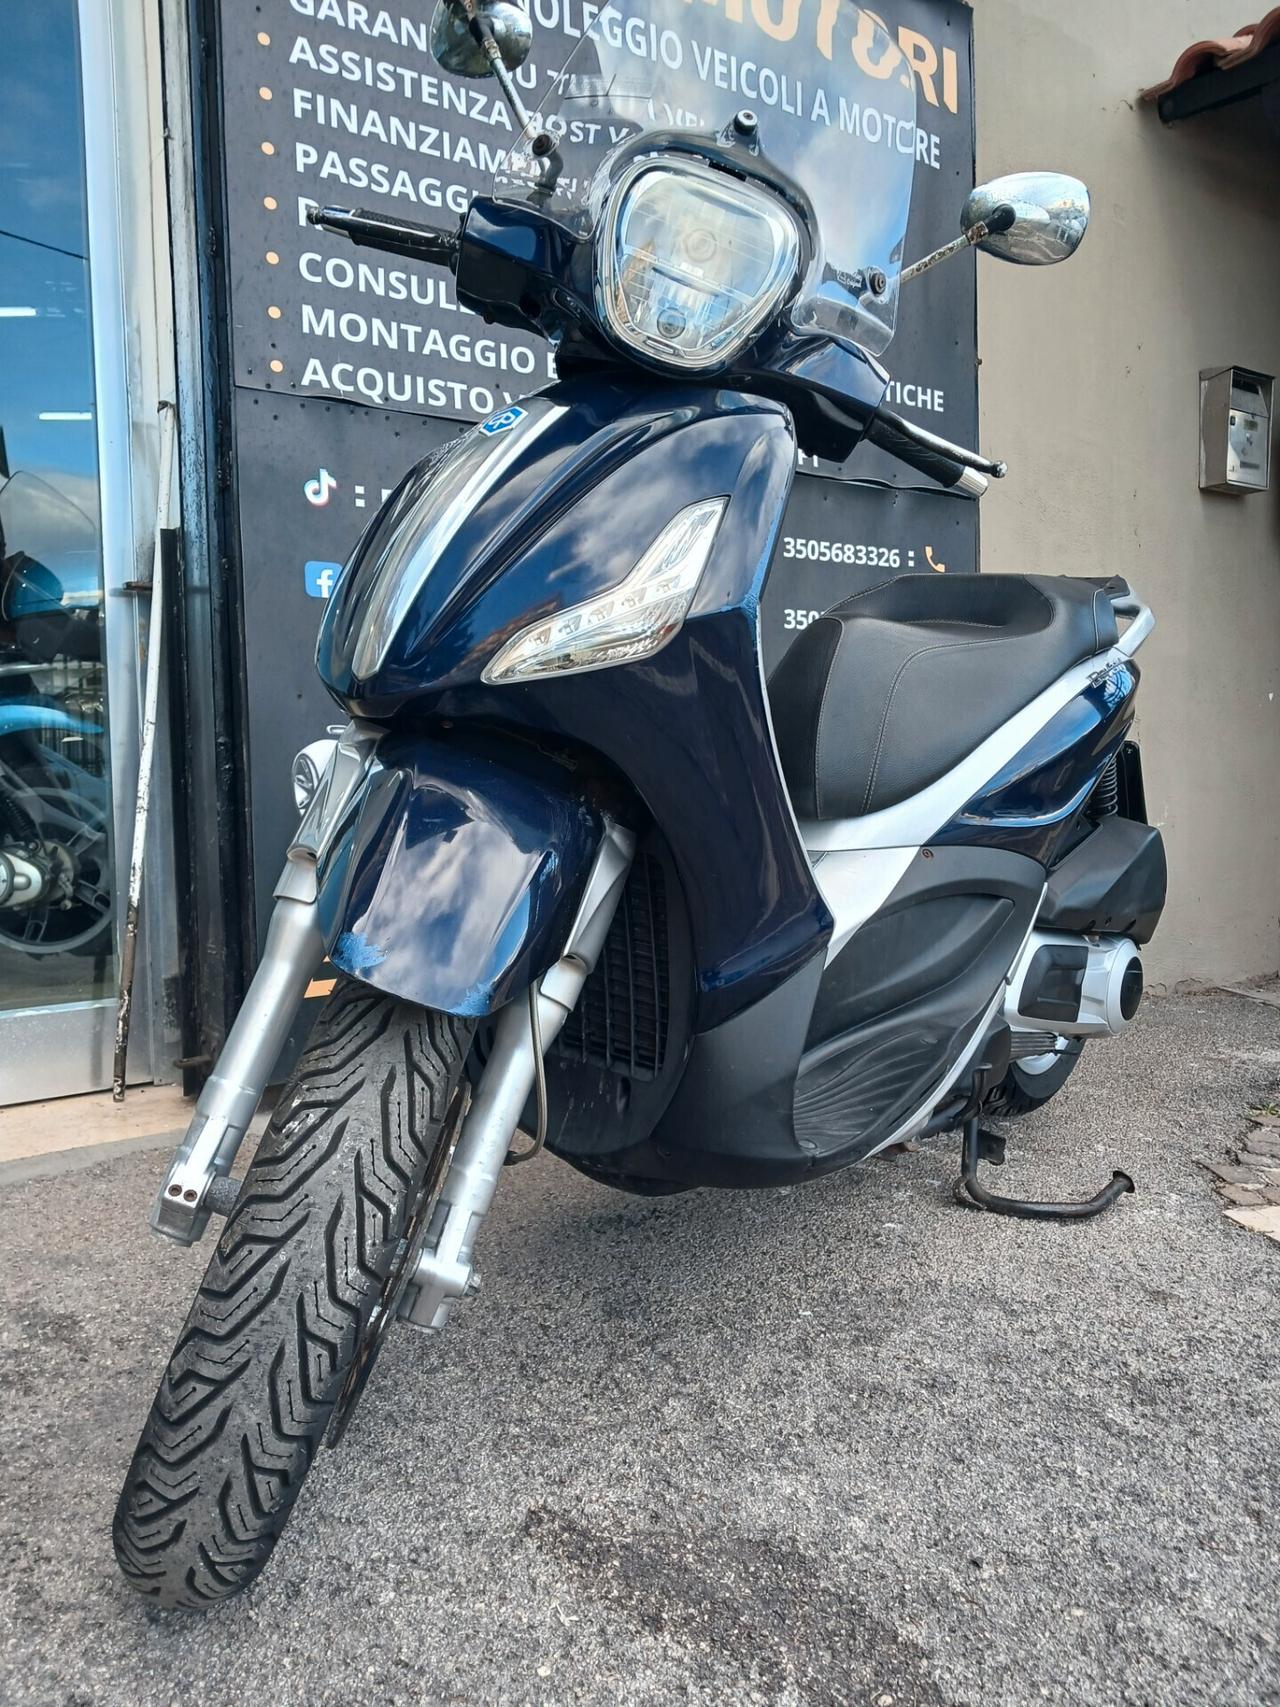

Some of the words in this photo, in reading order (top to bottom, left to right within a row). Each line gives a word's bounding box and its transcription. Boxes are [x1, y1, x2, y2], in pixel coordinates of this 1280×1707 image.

[289, 36, 513, 131] ASSISTENZA
[691, 40, 802, 117] VEICOLI
[810, 88, 831, 127] A
[838, 96, 940, 170] MOTORE
[295, 142, 478, 214] PASSAGG
[299, 252, 476, 315] CONSUL
[302, 304, 535, 374] MONTAGGIO
[300, 358, 494, 415] ACQUISTO
[783, 537, 901, 568] 3505683326
